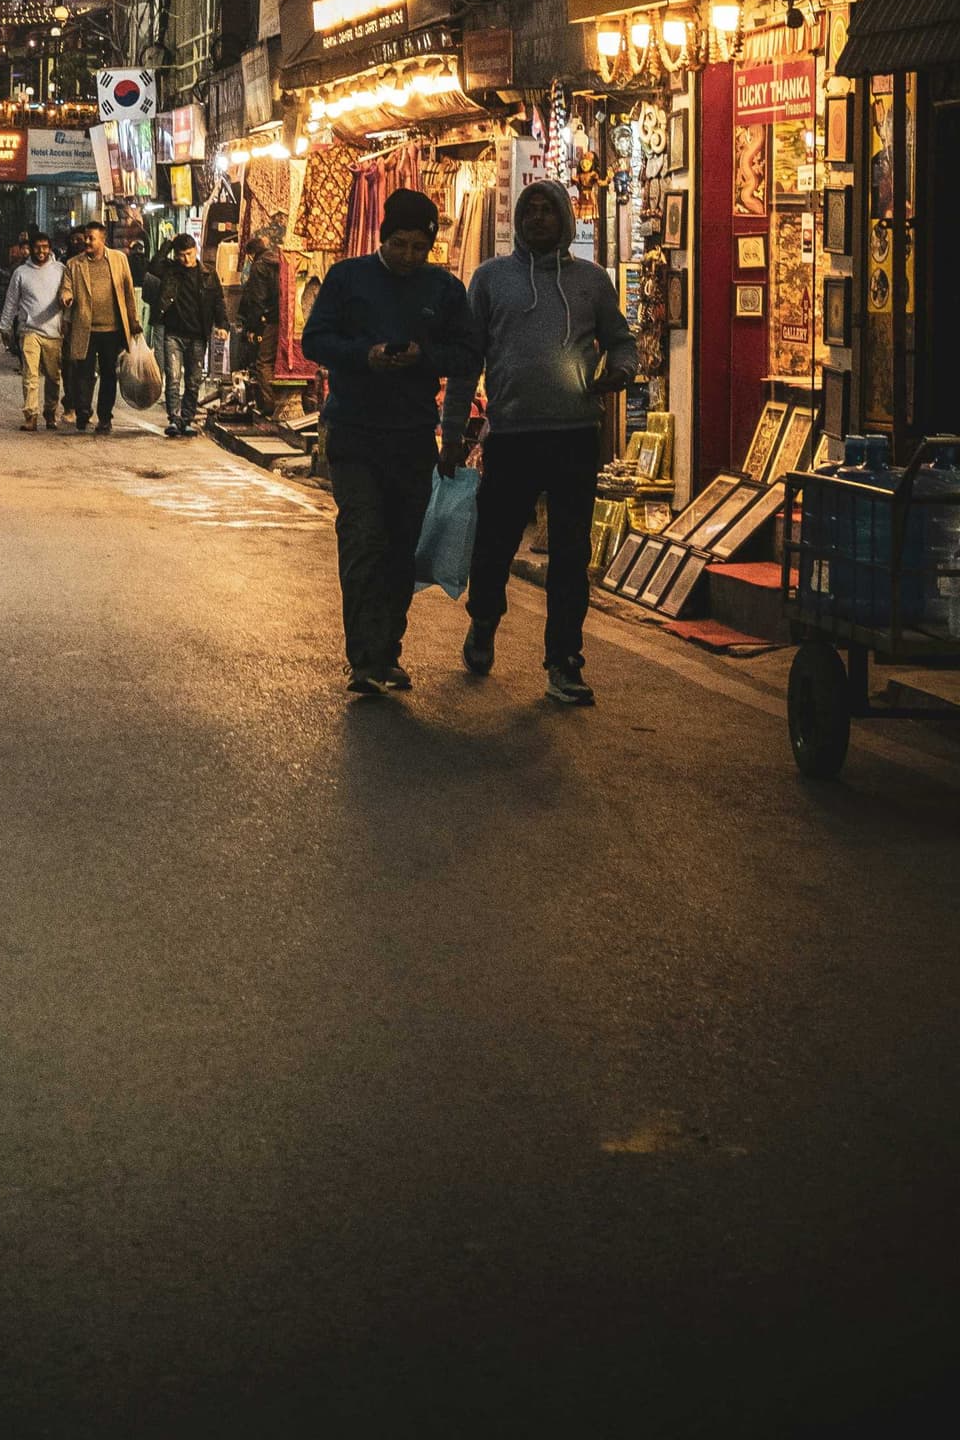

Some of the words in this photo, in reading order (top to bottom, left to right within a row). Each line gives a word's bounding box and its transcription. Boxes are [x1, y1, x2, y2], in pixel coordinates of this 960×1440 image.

[737, 81, 768, 108] LUCKY
[770, 75, 810, 103] THANKA
[31, 148, 48, 157] Hotel
[49, 148, 72, 157] Access
